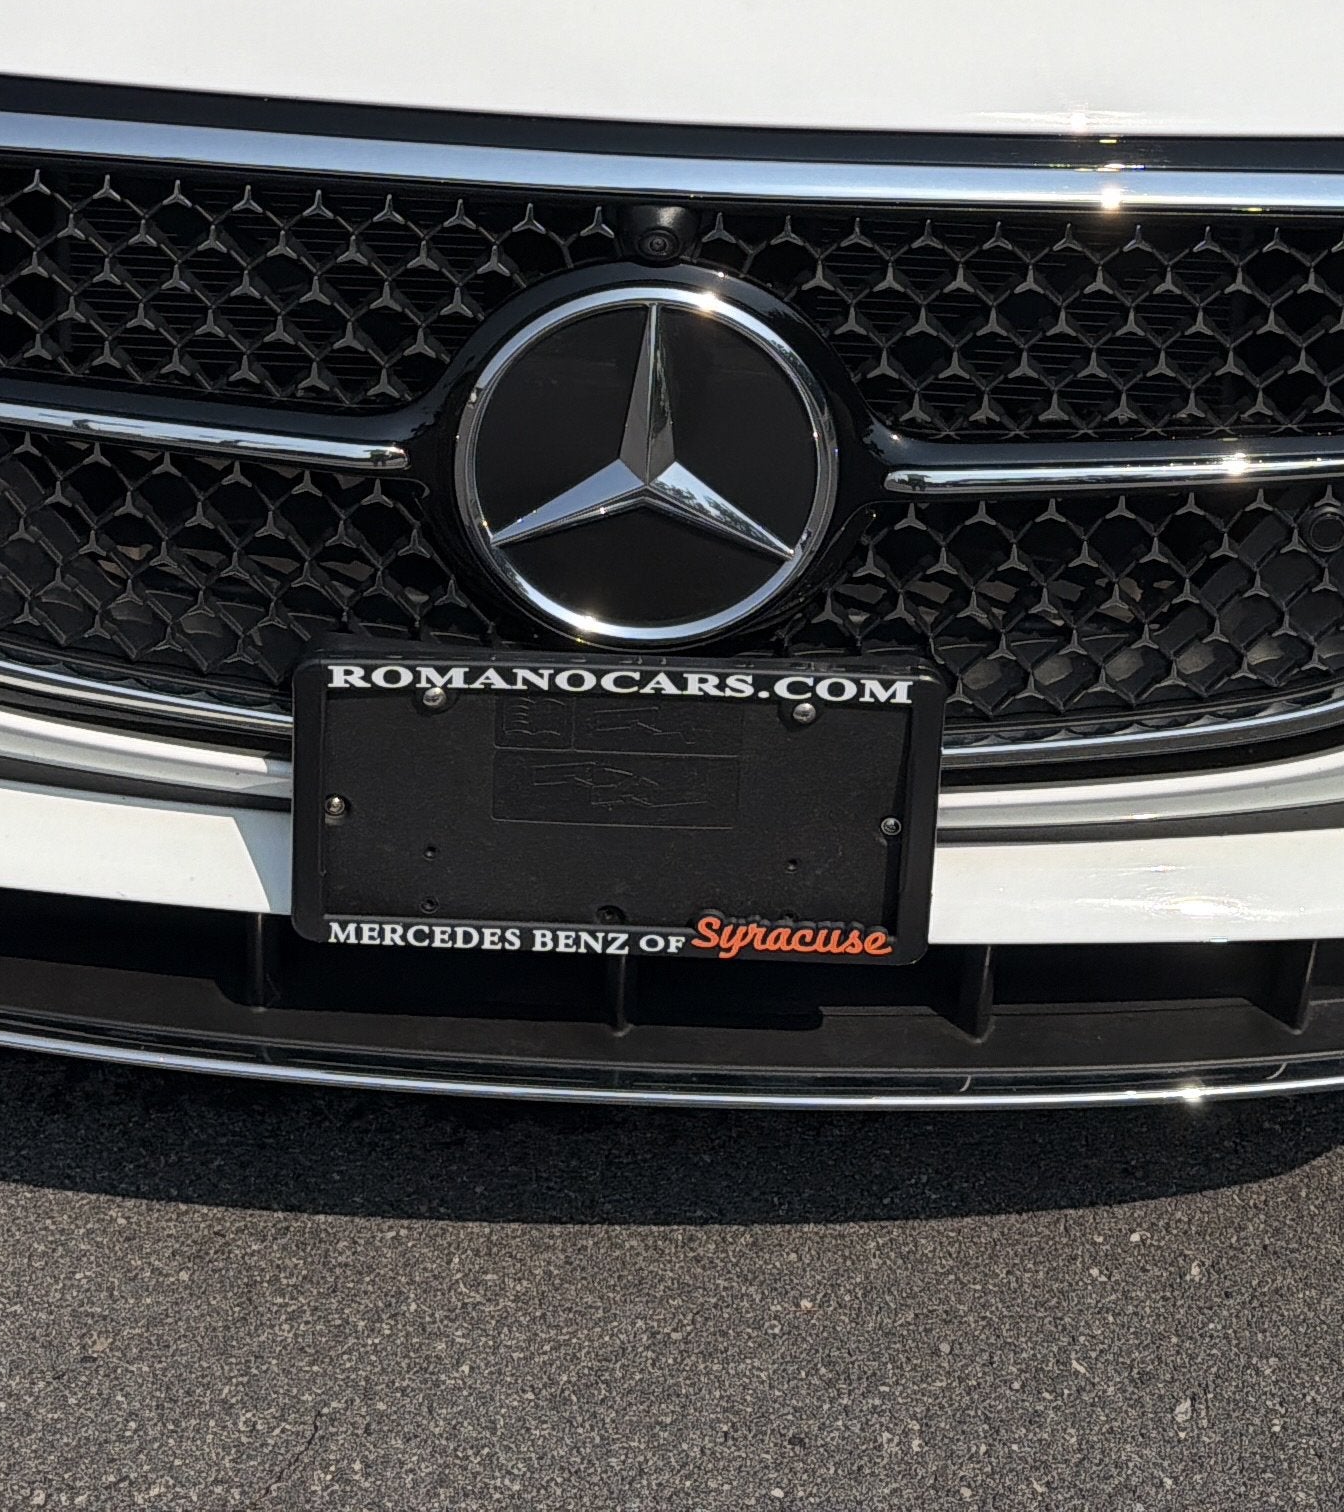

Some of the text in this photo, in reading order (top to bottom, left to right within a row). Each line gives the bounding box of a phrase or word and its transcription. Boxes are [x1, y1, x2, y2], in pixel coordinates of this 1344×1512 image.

[327, 665, 914, 704] ROMANOCARS.COM
[328, 916, 893, 959] MERCEDES BENZ OF Syracuse
